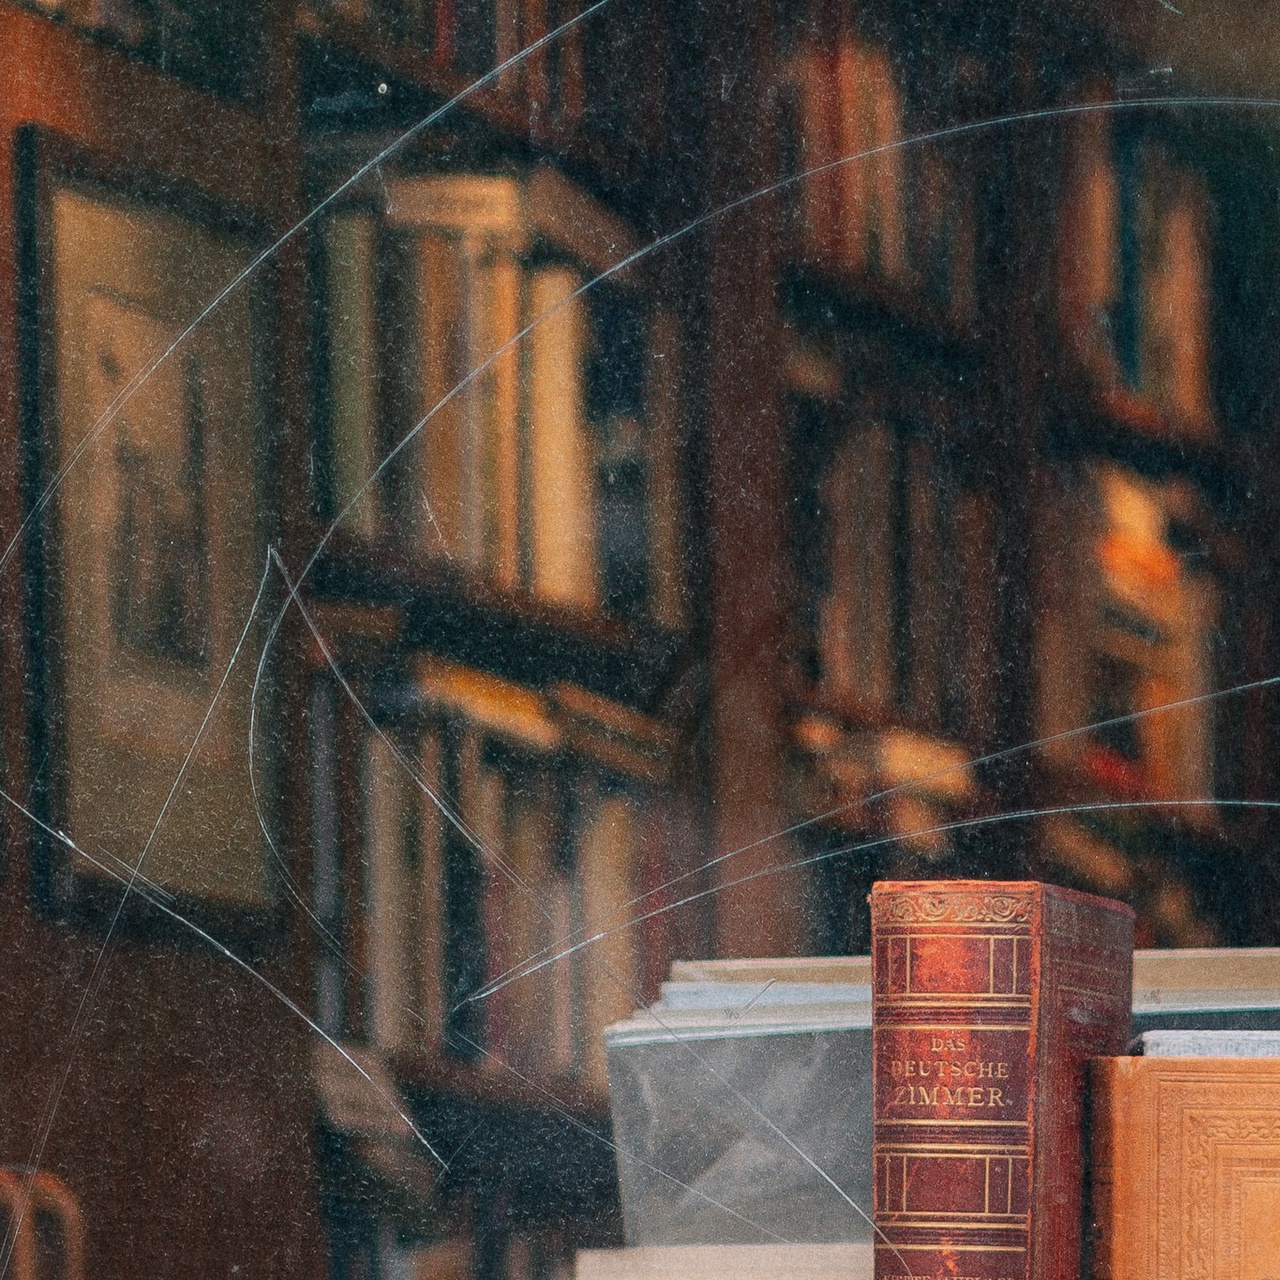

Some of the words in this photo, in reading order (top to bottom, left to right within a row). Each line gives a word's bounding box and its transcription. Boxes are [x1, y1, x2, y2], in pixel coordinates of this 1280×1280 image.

[931, 1037, 966, 1051] DAS
[892, 1060, 1009, 1078] DEUTSCHE
[895, 1085, 1005, 1107] ZIMMER
